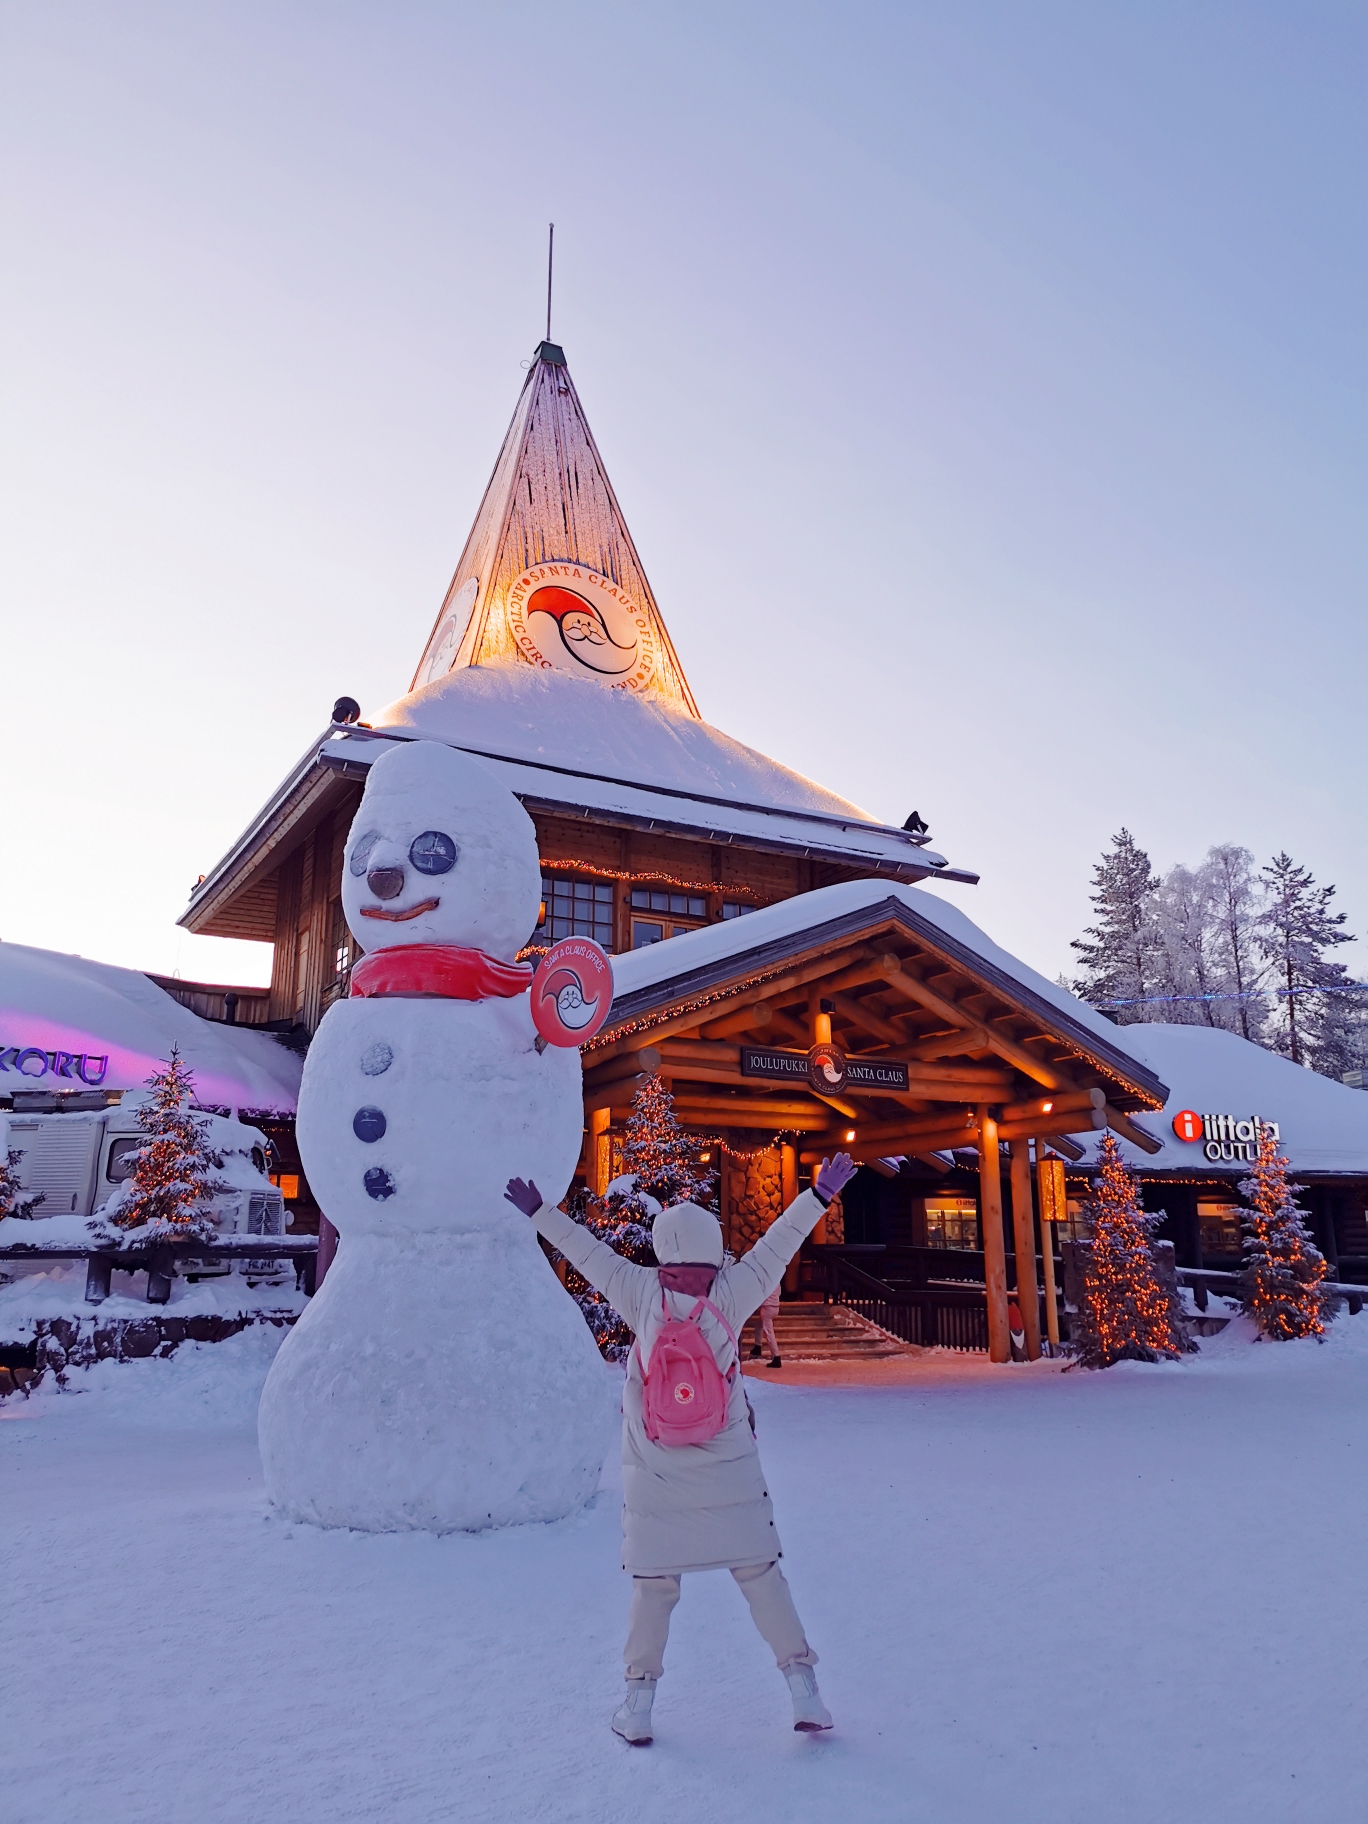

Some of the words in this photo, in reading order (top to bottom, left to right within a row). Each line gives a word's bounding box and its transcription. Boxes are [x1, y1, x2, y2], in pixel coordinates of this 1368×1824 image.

[510, 582, 527, 634] ARCTIC
[520, 637, 552, 670] CIRC
[529, 565, 583, 582] SANTA
[588, 574, 637, 614] CLAUS
[635, 618, 654, 673] OFFICE
[565, 945, 586, 957] CLAUS
[585, 949, 606, 973] OFFICE
[750, 1055, 808, 1073] JOULUPUKKI
[847, 1066, 875, 1080] SANTA
[876, 1069, 904, 1083] CLAUS
[1203, 1114, 1280, 1141] iittala
[1205, 1141, 1277, 1161] OUTL
